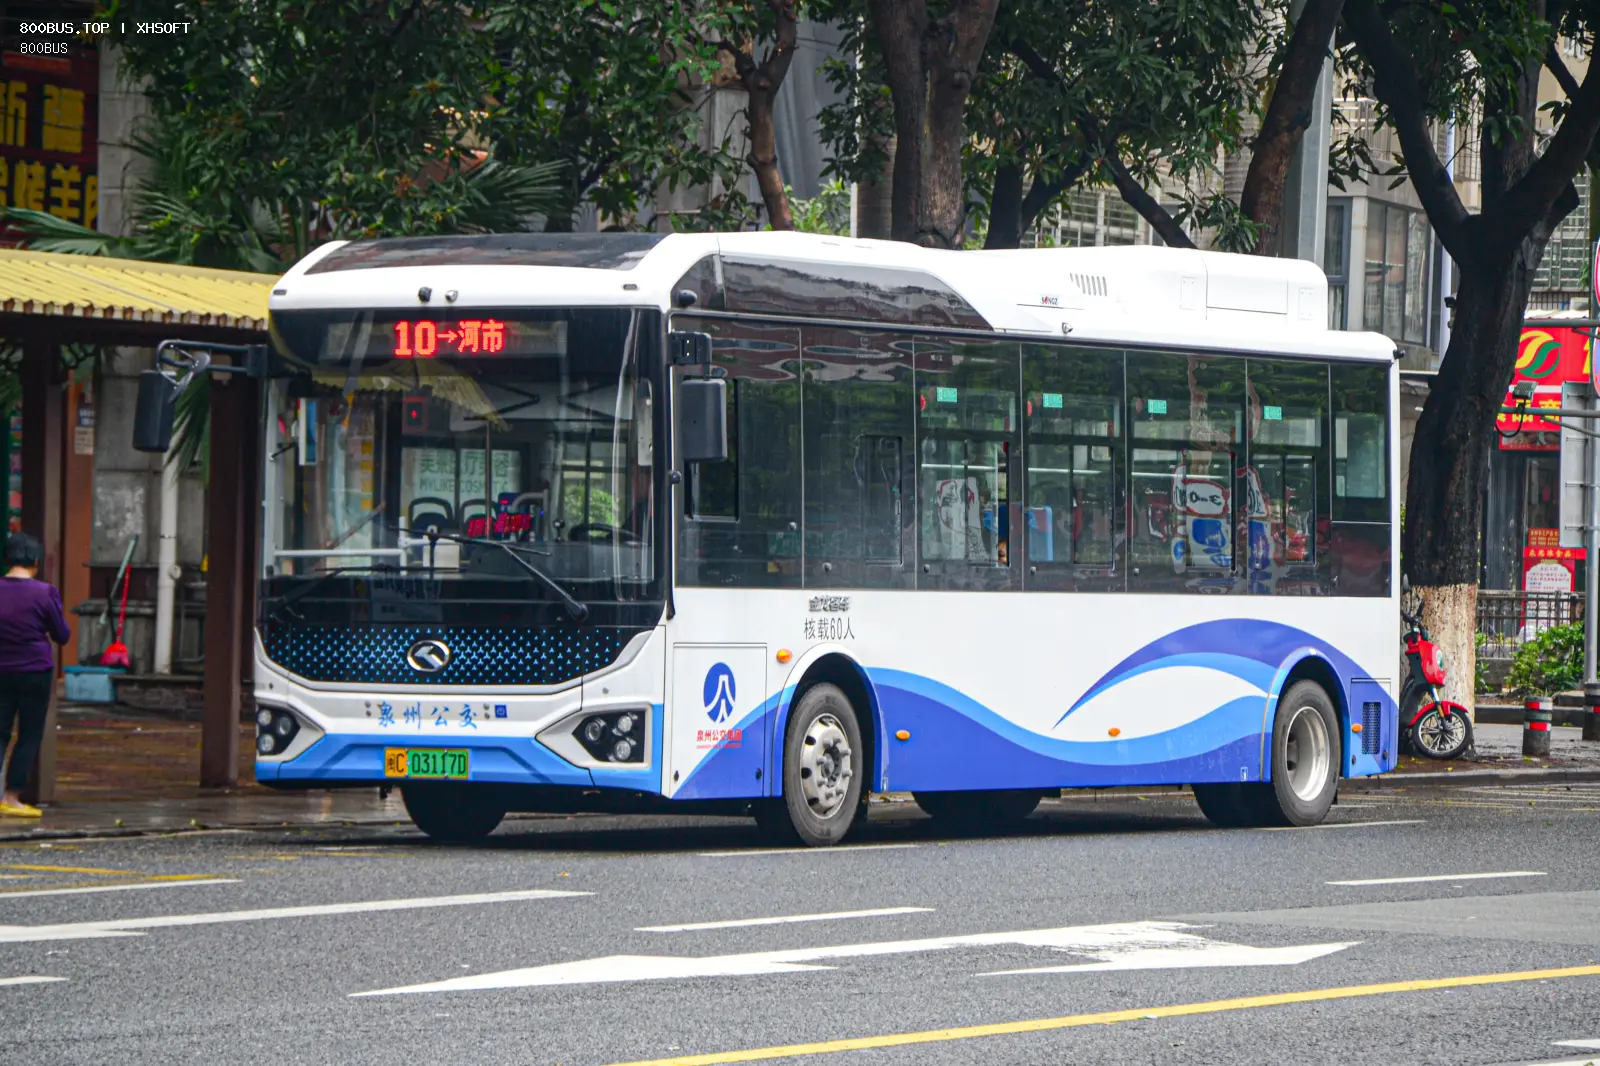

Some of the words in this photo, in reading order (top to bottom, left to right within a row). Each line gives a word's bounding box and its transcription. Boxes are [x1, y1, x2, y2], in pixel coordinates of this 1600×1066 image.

[394, 320, 437, 357] 10
[457, 318, 505, 354] 河市
[803, 617, 855, 640] 核载60人
[377, 701, 478, 729] 泉州公交
[696, 728, 743, 742] 泉州公交集团
